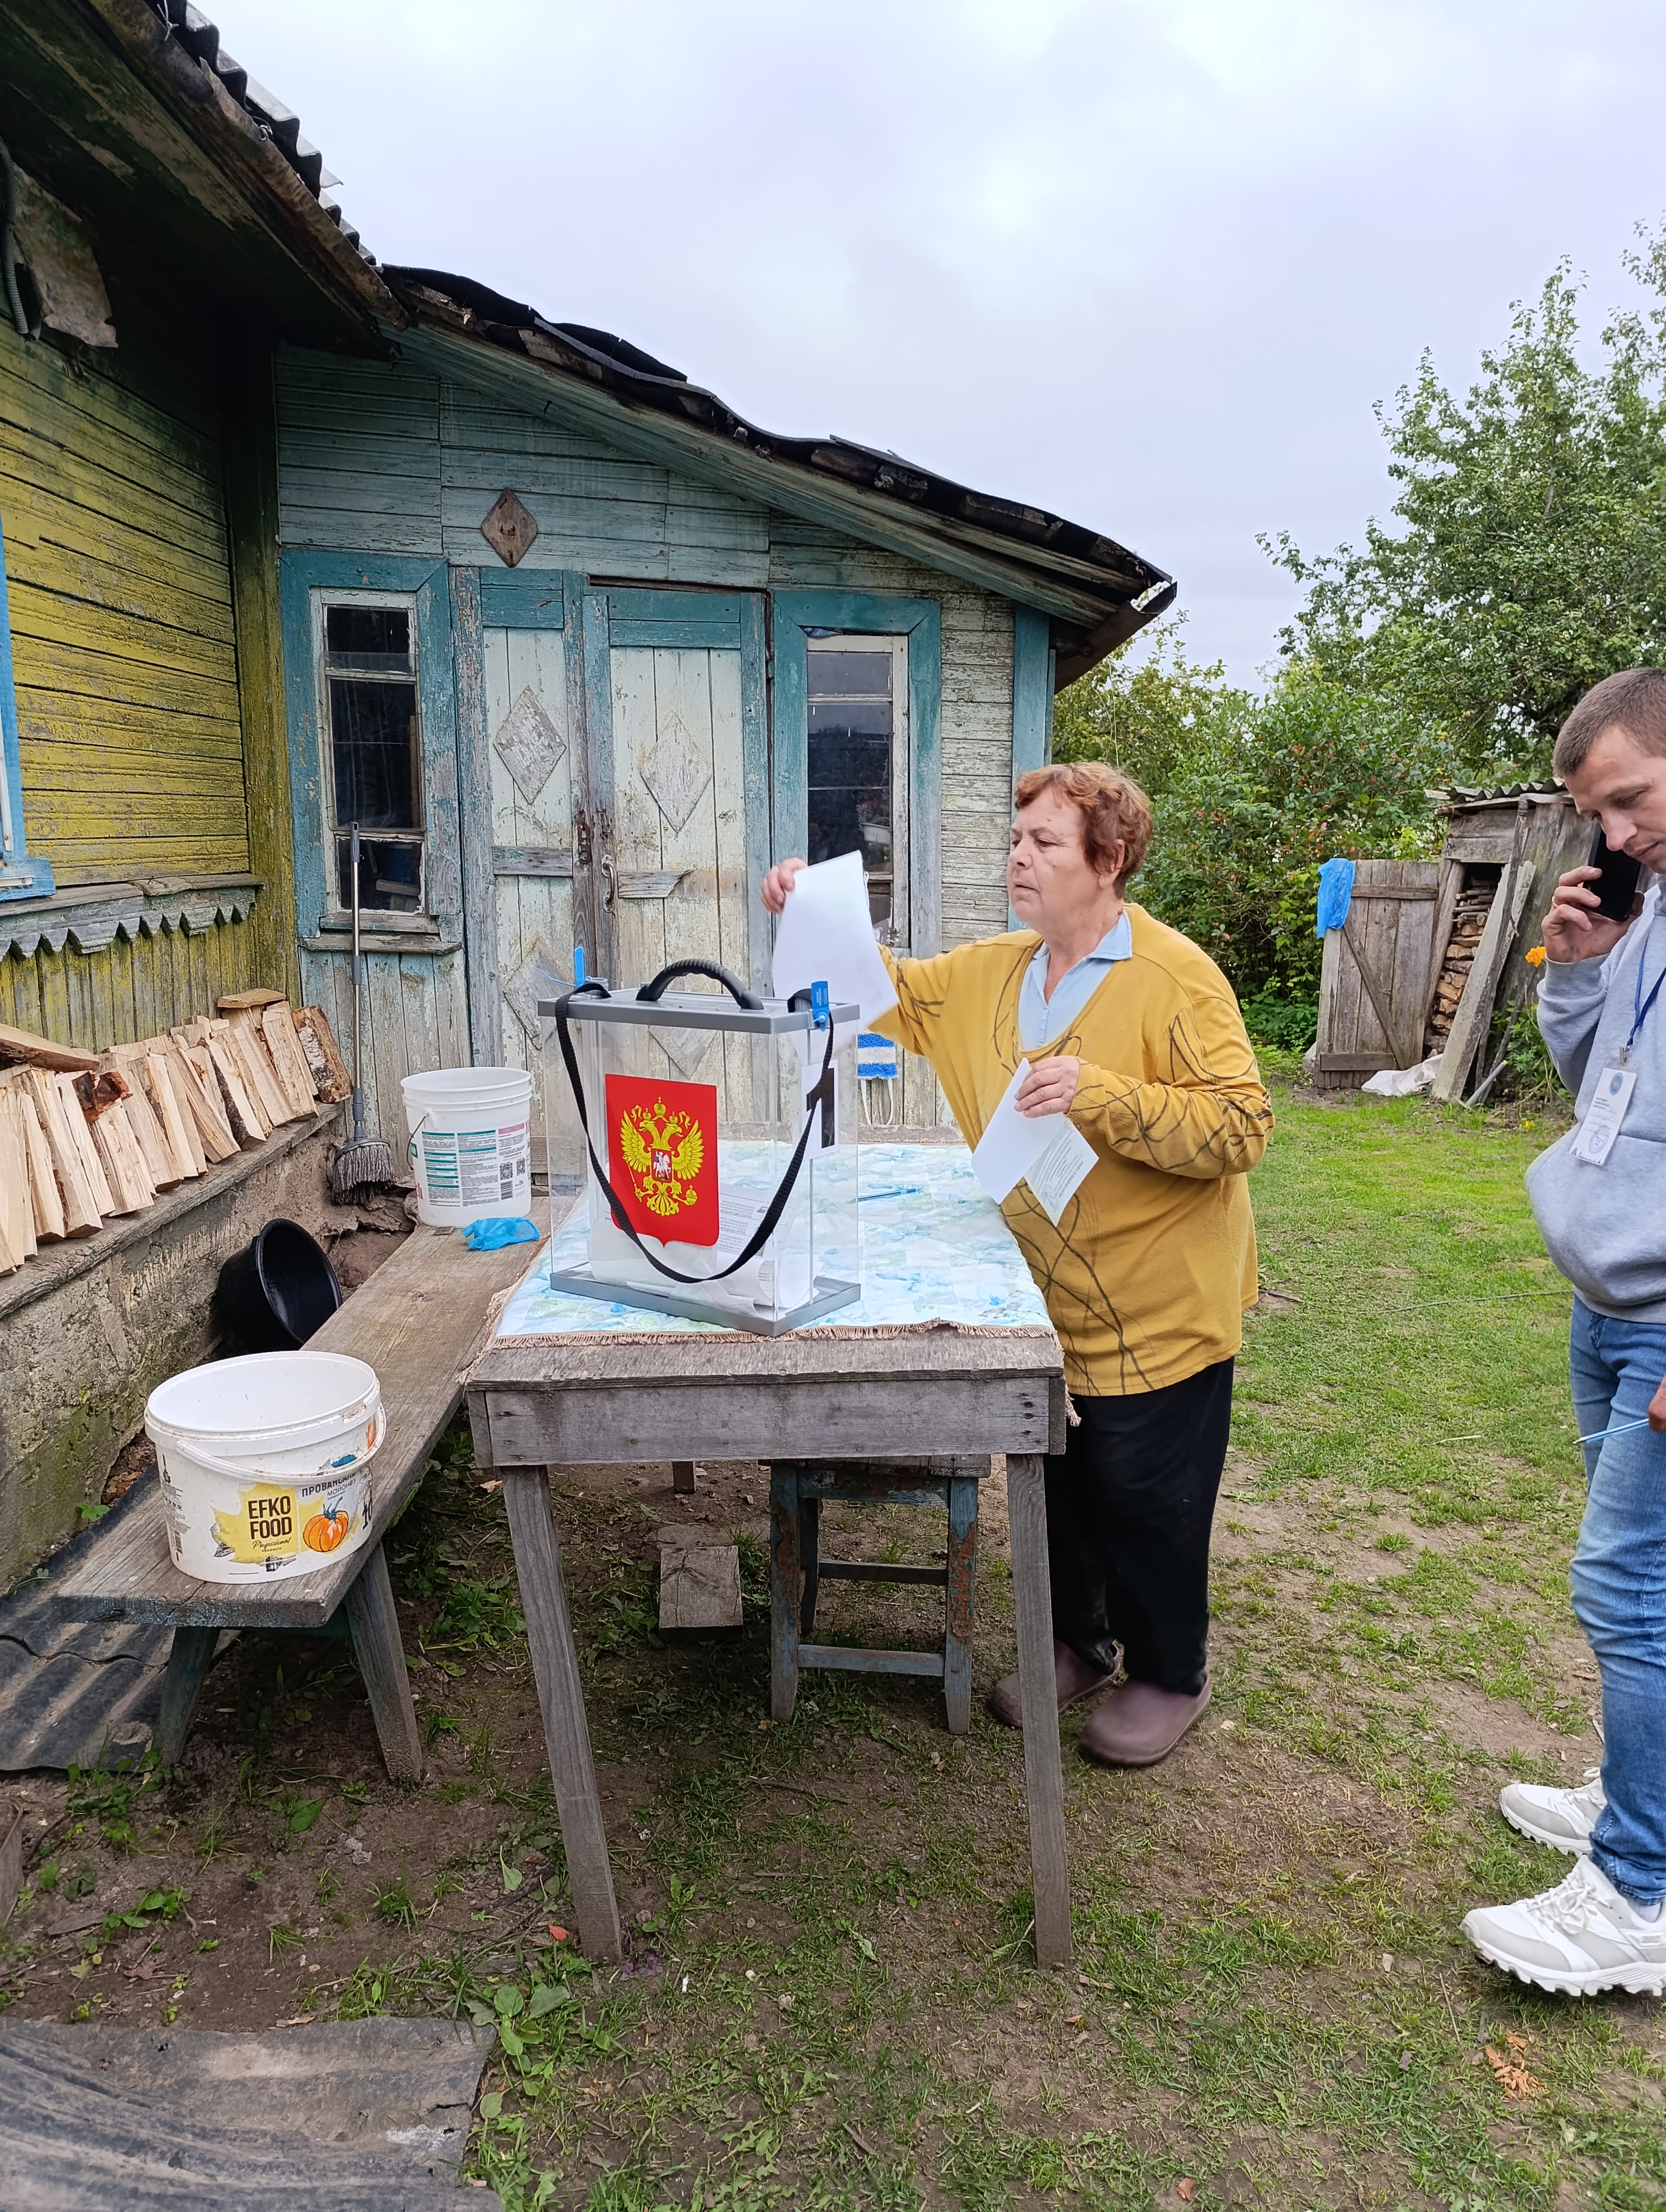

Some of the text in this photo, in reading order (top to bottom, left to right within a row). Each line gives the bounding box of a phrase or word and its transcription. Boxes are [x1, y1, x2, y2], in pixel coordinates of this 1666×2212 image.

[806, 1068, 835, 1148] 1
[328, 1478, 356, 1497] майонез
[248, 1496, 291, 1519] EFKO
[250, 1516, 292, 1540] FOOD
